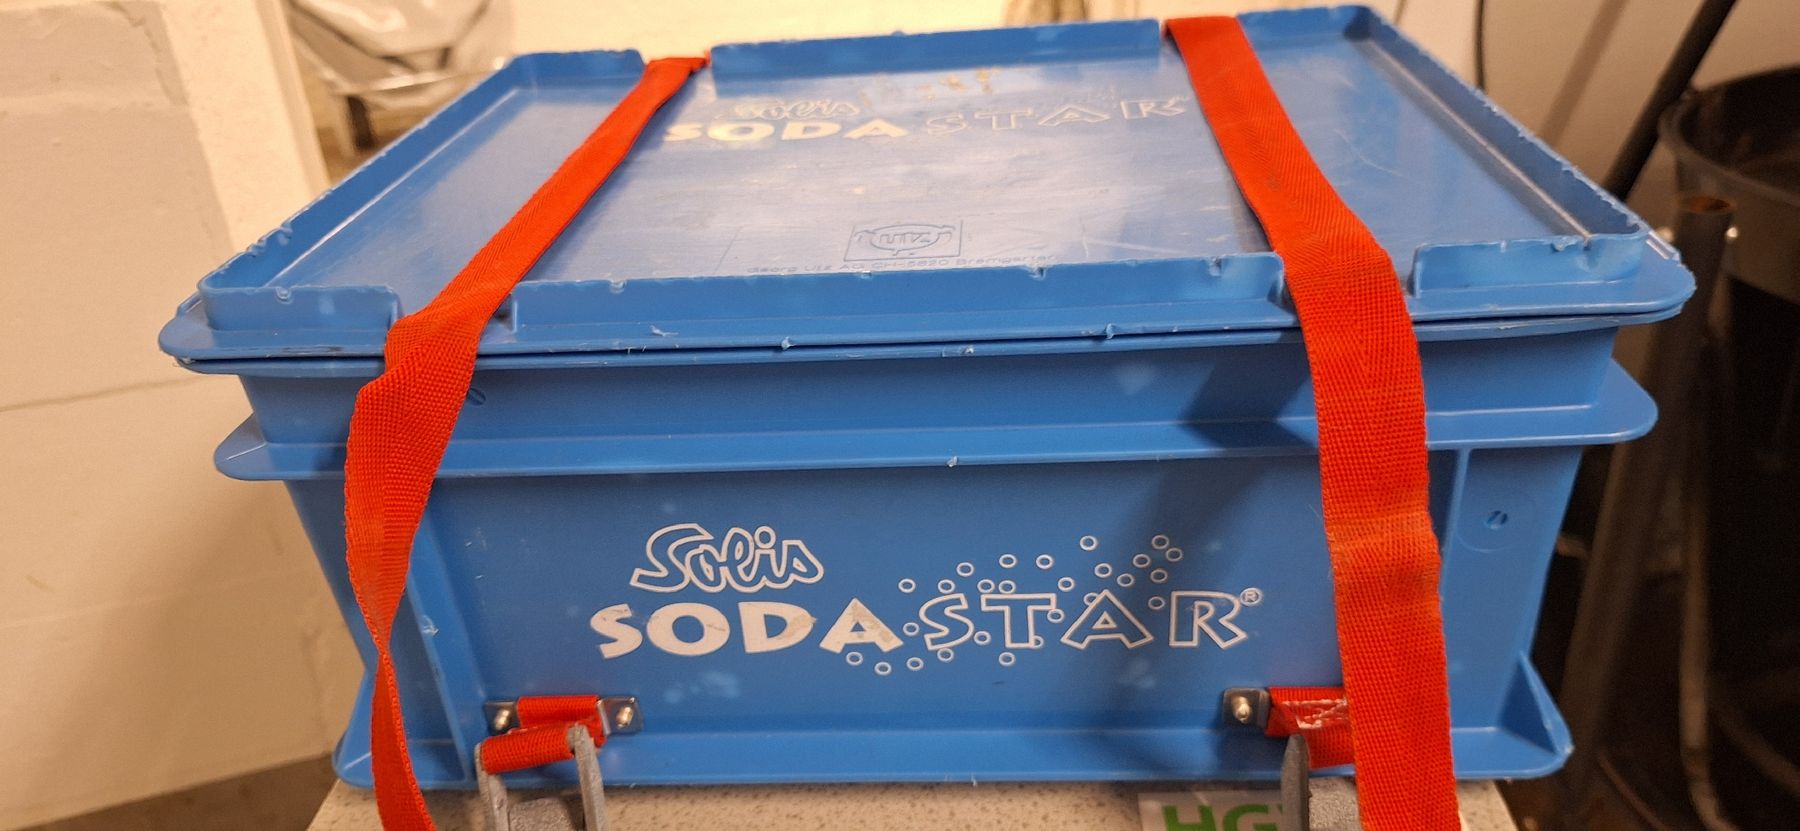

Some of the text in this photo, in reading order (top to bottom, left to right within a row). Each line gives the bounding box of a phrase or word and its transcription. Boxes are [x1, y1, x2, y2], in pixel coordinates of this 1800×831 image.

[663, 117, 909, 142] SODA
[629, 523, 825, 593] Solis
[589, 597, 904, 659] SODA
